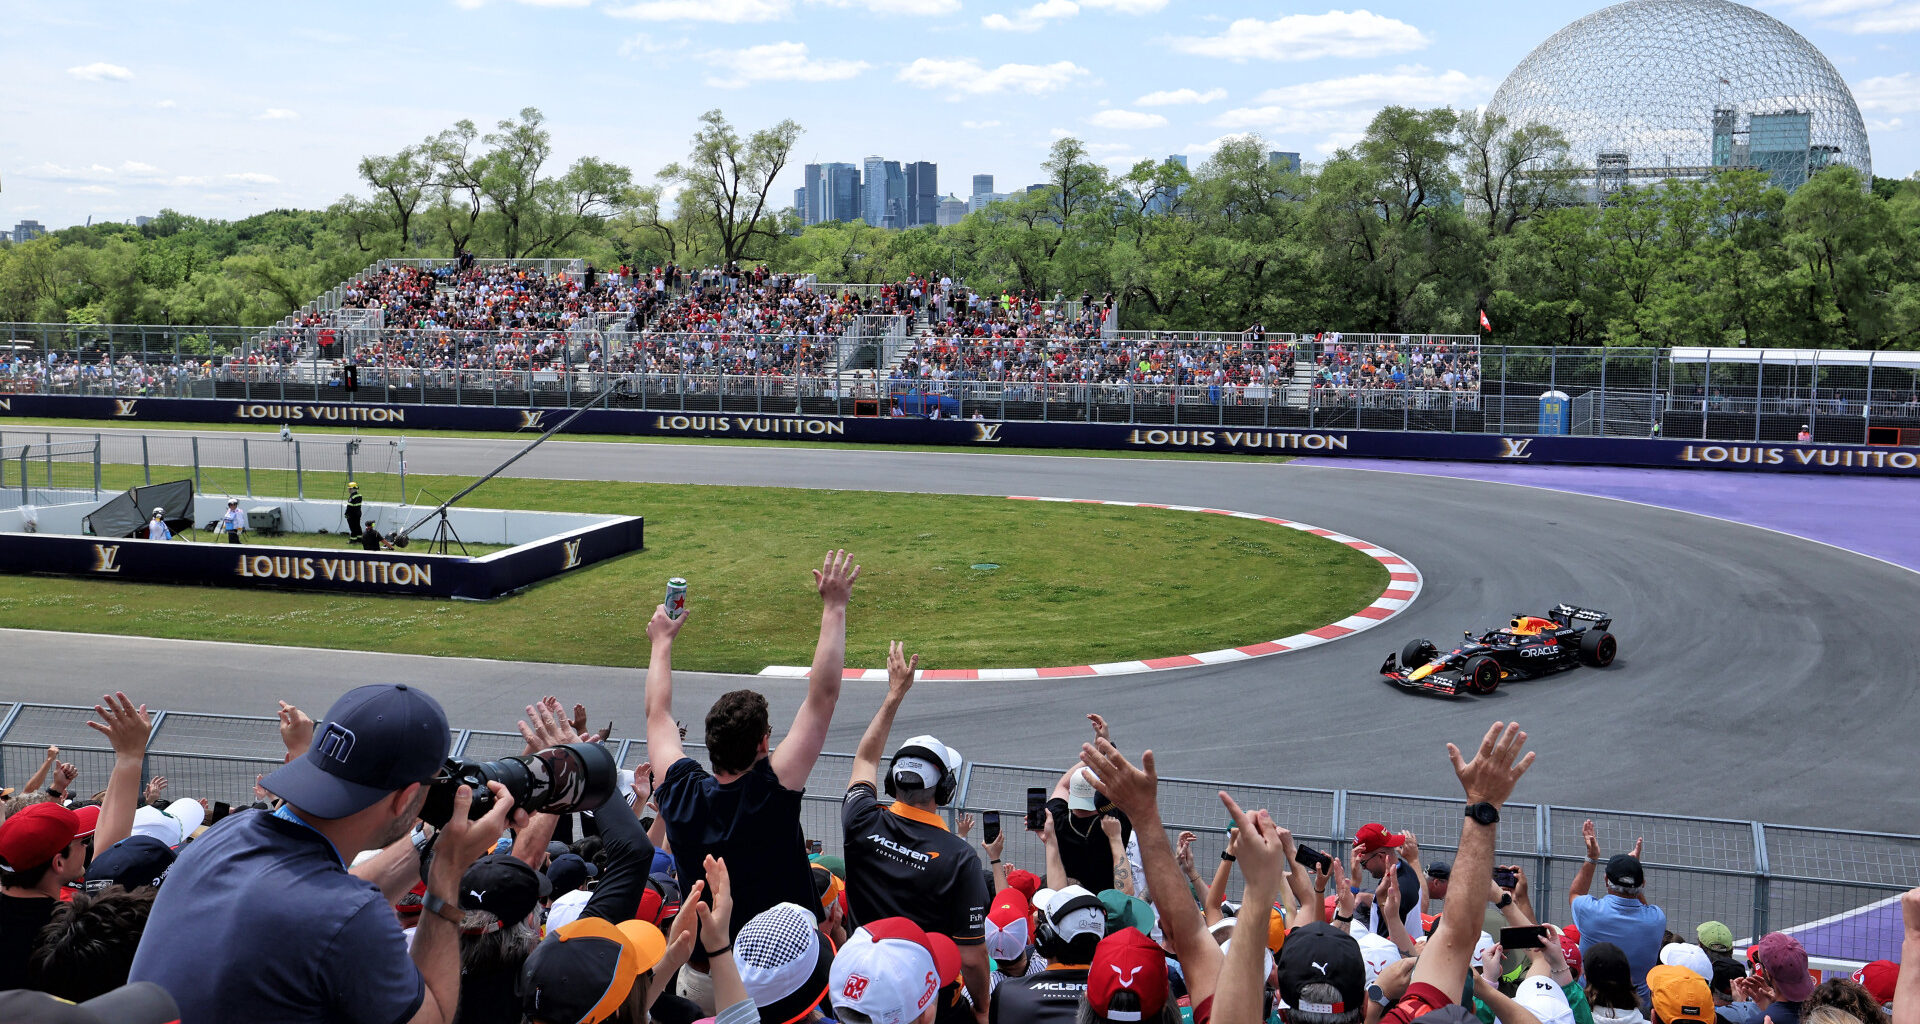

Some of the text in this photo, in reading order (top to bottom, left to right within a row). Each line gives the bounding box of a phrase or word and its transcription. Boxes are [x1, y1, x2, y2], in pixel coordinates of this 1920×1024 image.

[238, 404, 405, 423] LOUIS VUITTON
[657, 415, 845, 435] LOUIS VUITTON
[1132, 429, 1349, 450] LOUIS VUITTON
[1686, 445, 1920, 469] LOUIS VUITTO
[239, 554, 432, 586] LOUIS VUITTON
[1520, 645, 1559, 658] ORACLE
[866, 834, 930, 863] McLaren
[875, 848, 903, 863] FORMULA
[911, 862, 926, 871] TEAM
[1029, 982, 1088, 991] McLare
